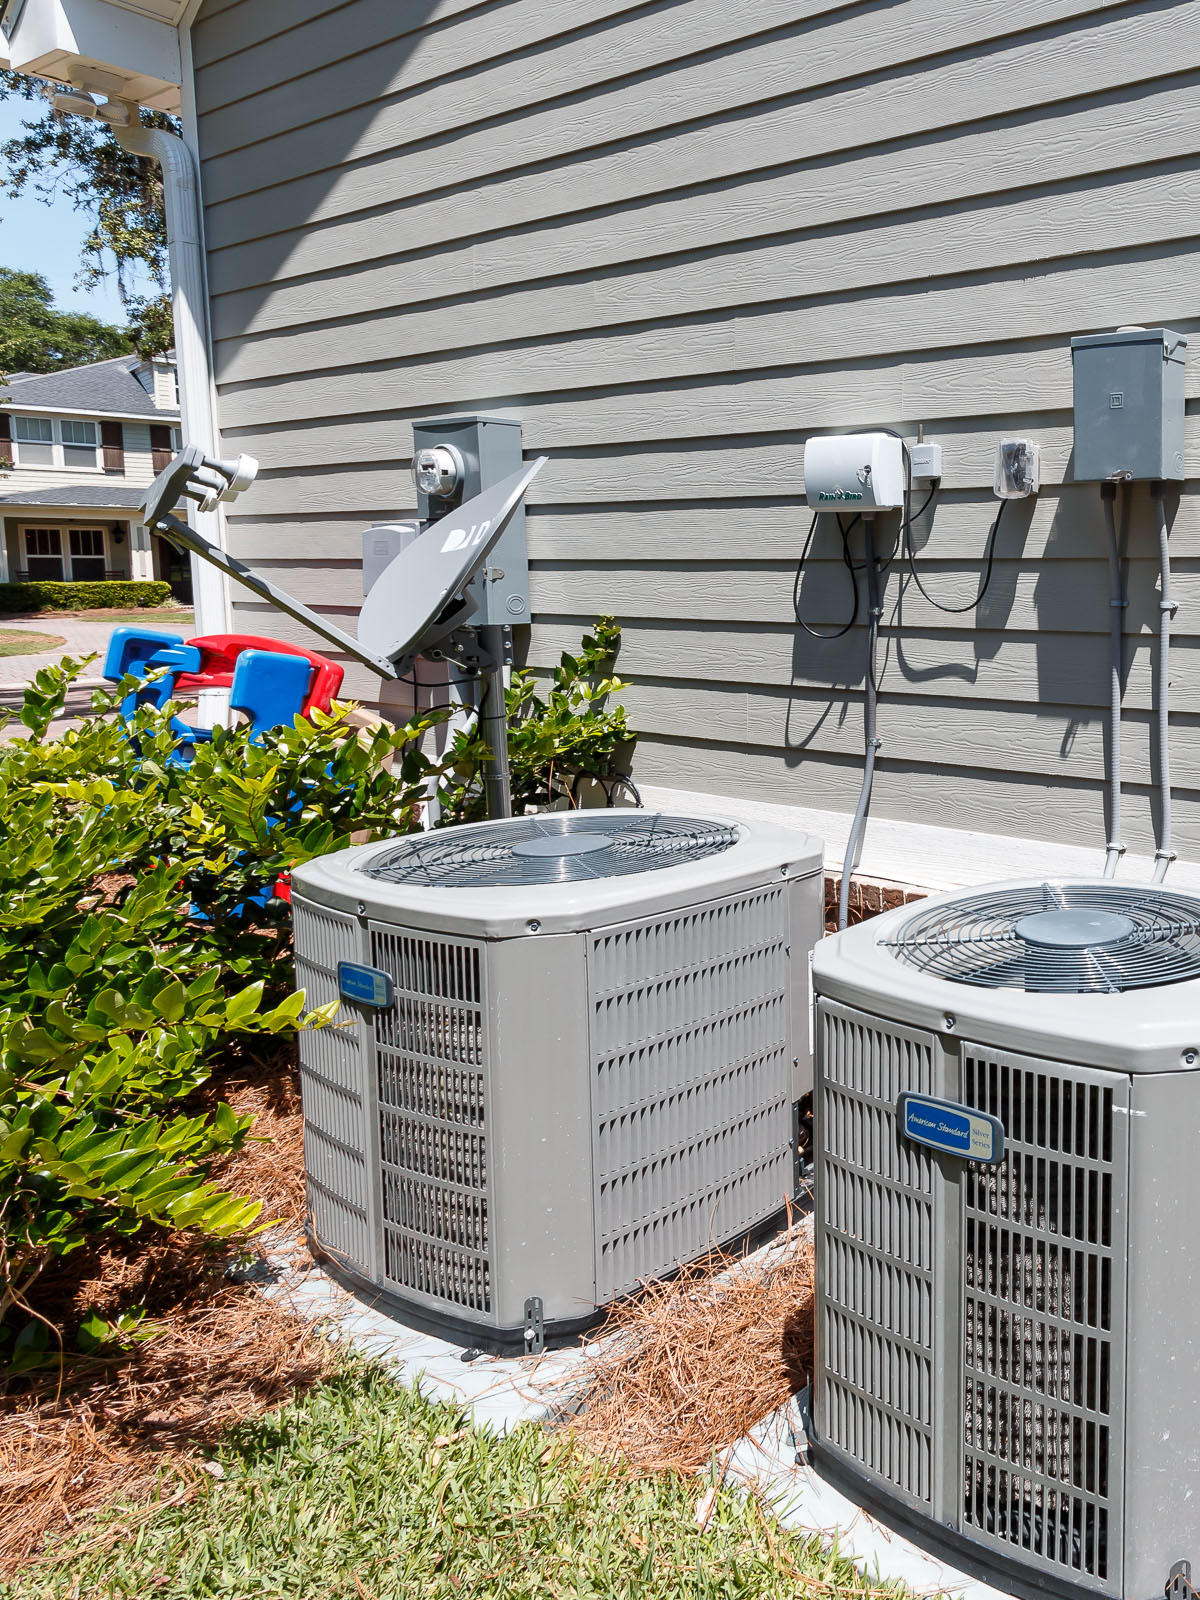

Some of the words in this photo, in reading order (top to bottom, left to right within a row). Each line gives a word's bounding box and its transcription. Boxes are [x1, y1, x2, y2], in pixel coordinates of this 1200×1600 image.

[819, 491, 836, 500] RAIN
[845, 491, 863, 500] BIRD
[908, 1113, 936, 1128] American
[937, 1122, 969, 1138] Standard
[972, 1129, 989, 1139] Silver
[971, 1139, 991, 1148] Series
